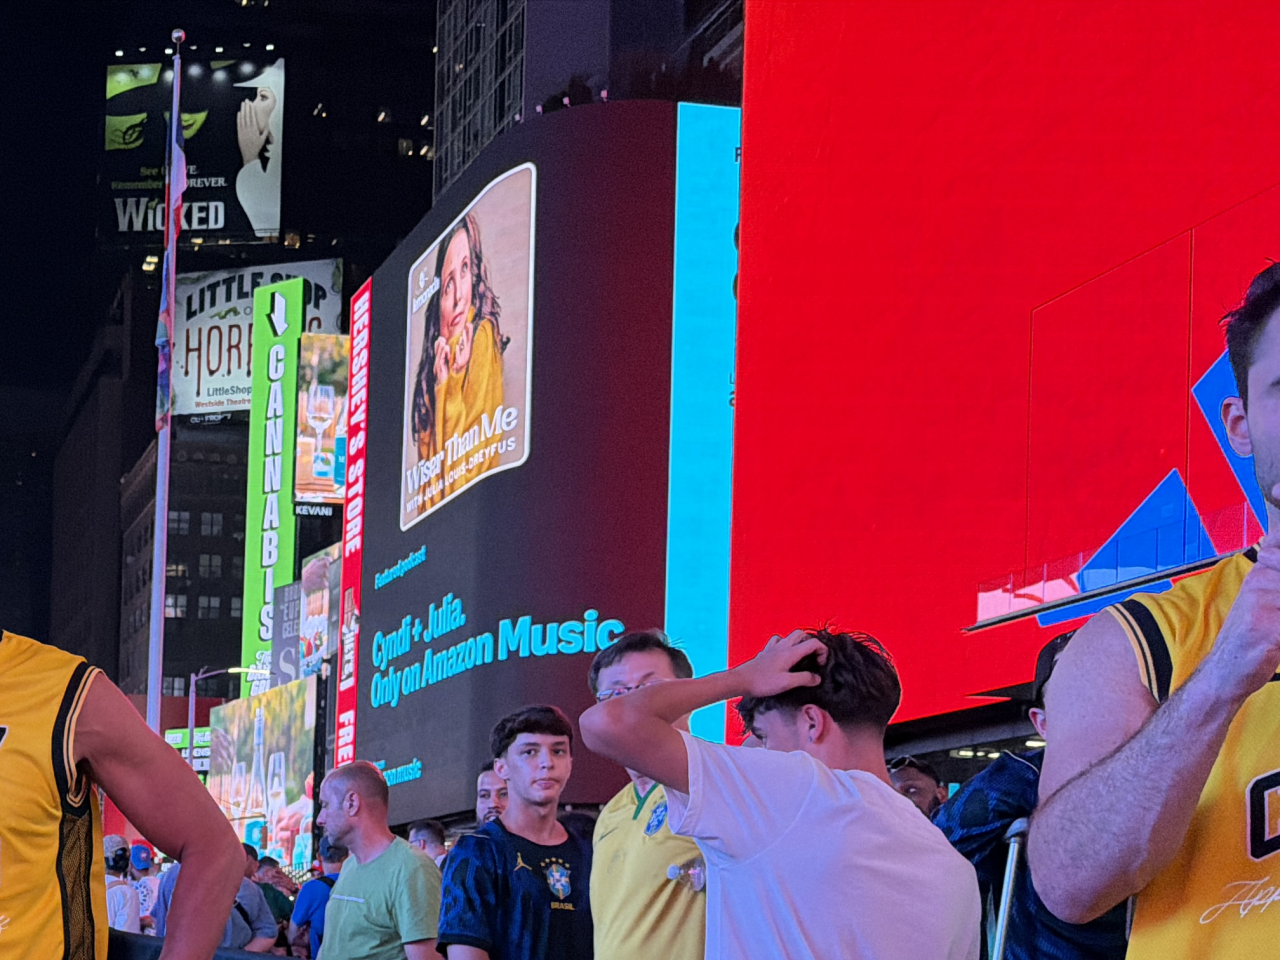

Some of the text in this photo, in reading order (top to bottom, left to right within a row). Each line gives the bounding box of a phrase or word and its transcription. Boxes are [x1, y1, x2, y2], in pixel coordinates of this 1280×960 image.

[344, 290, 371, 558] HERSHEY'S STORE
[406, 404, 519, 494] Wiser Than Me
[260, 343, 287, 641] CANNABIS
[295, 505, 333, 517] KEVANI
[371, 608, 625, 708] Only on Amazon Music
[372, 615, 412, 671] Cyndi
[423, 592, 467, 643] Julia.
